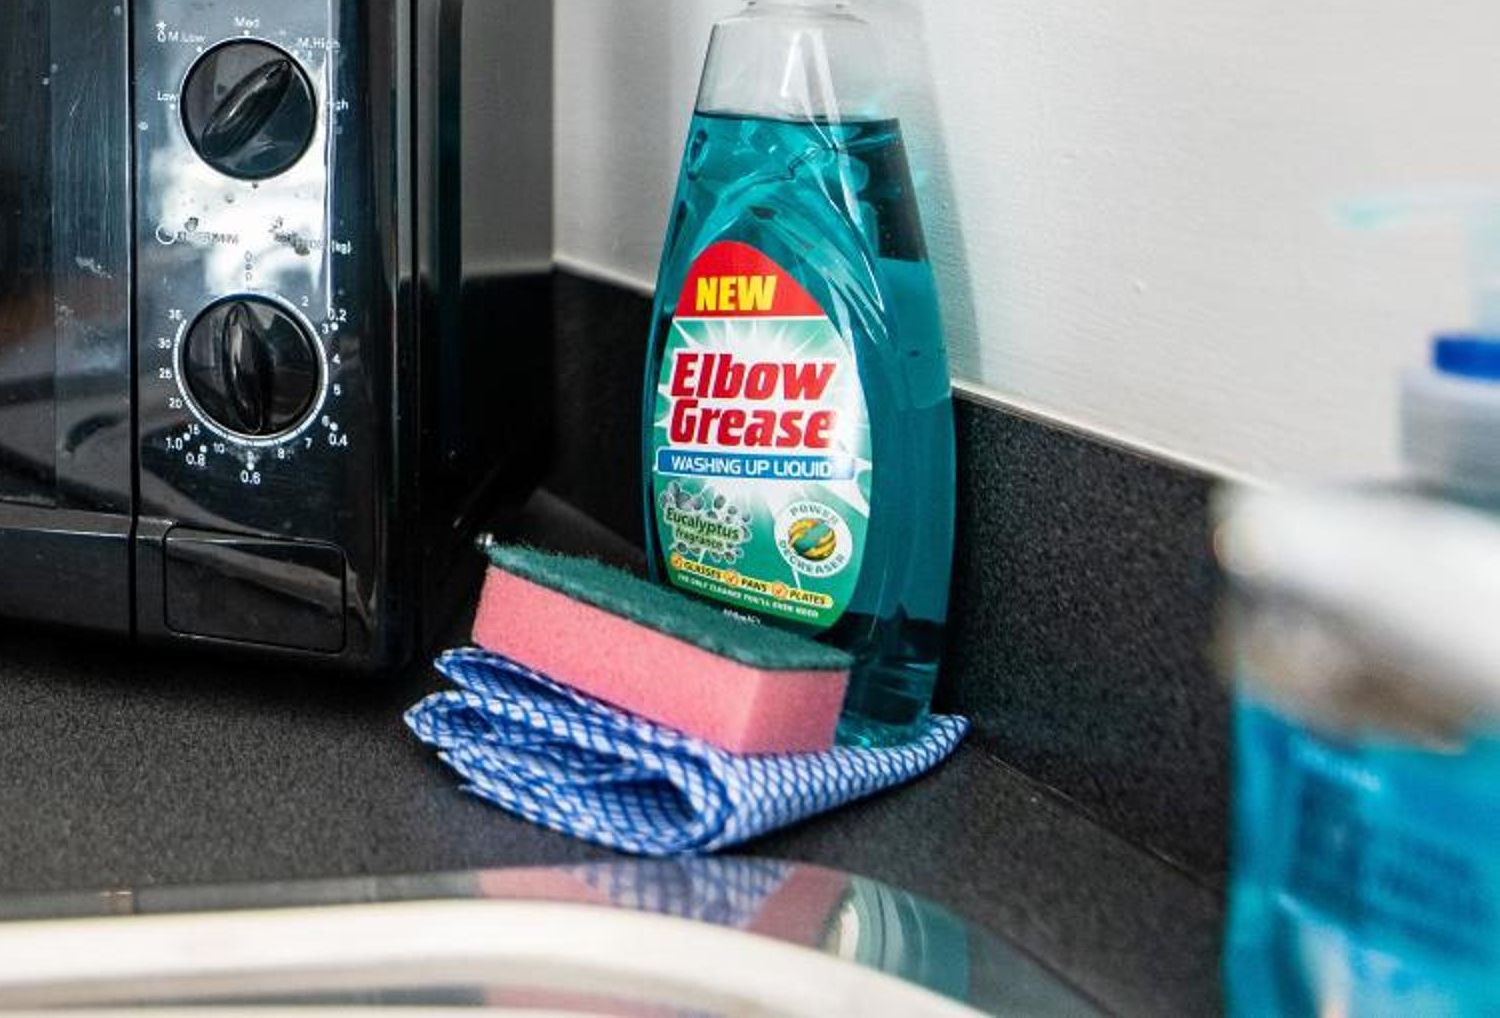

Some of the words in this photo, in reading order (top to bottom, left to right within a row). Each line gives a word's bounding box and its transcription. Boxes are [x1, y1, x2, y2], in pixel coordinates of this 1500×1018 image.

[157, 91, 176, 102] Low
[695, 275, 777, 311] NEW
[301, 296, 309, 307] 2
[328, 308, 347, 321] 0.2
[322, 323, 329, 335] 3
[157, 338, 171, 349] 30
[332, 354, 341, 365] 4
[670, 353, 837, 401] Elbow
[333, 384, 341, 396] 5
[168, 397, 182, 409] 20
[669, 399, 837, 449] Grease
[165, 436, 183, 451] 1.0
[304, 438, 313, 449] 7
[328, 433, 348, 447] 0.4
[213, 442, 225, 455] 10
[185, 452, 206, 468] 0.8
[671, 455, 742, 473] WASHING
[745, 459, 770, 475] UP
[774, 460, 833, 477] LIQUID
[666, 507, 740, 541] Eucalyptus
[741, 577, 767, 593] PANS
[789, 589, 826, 606] PLATES
